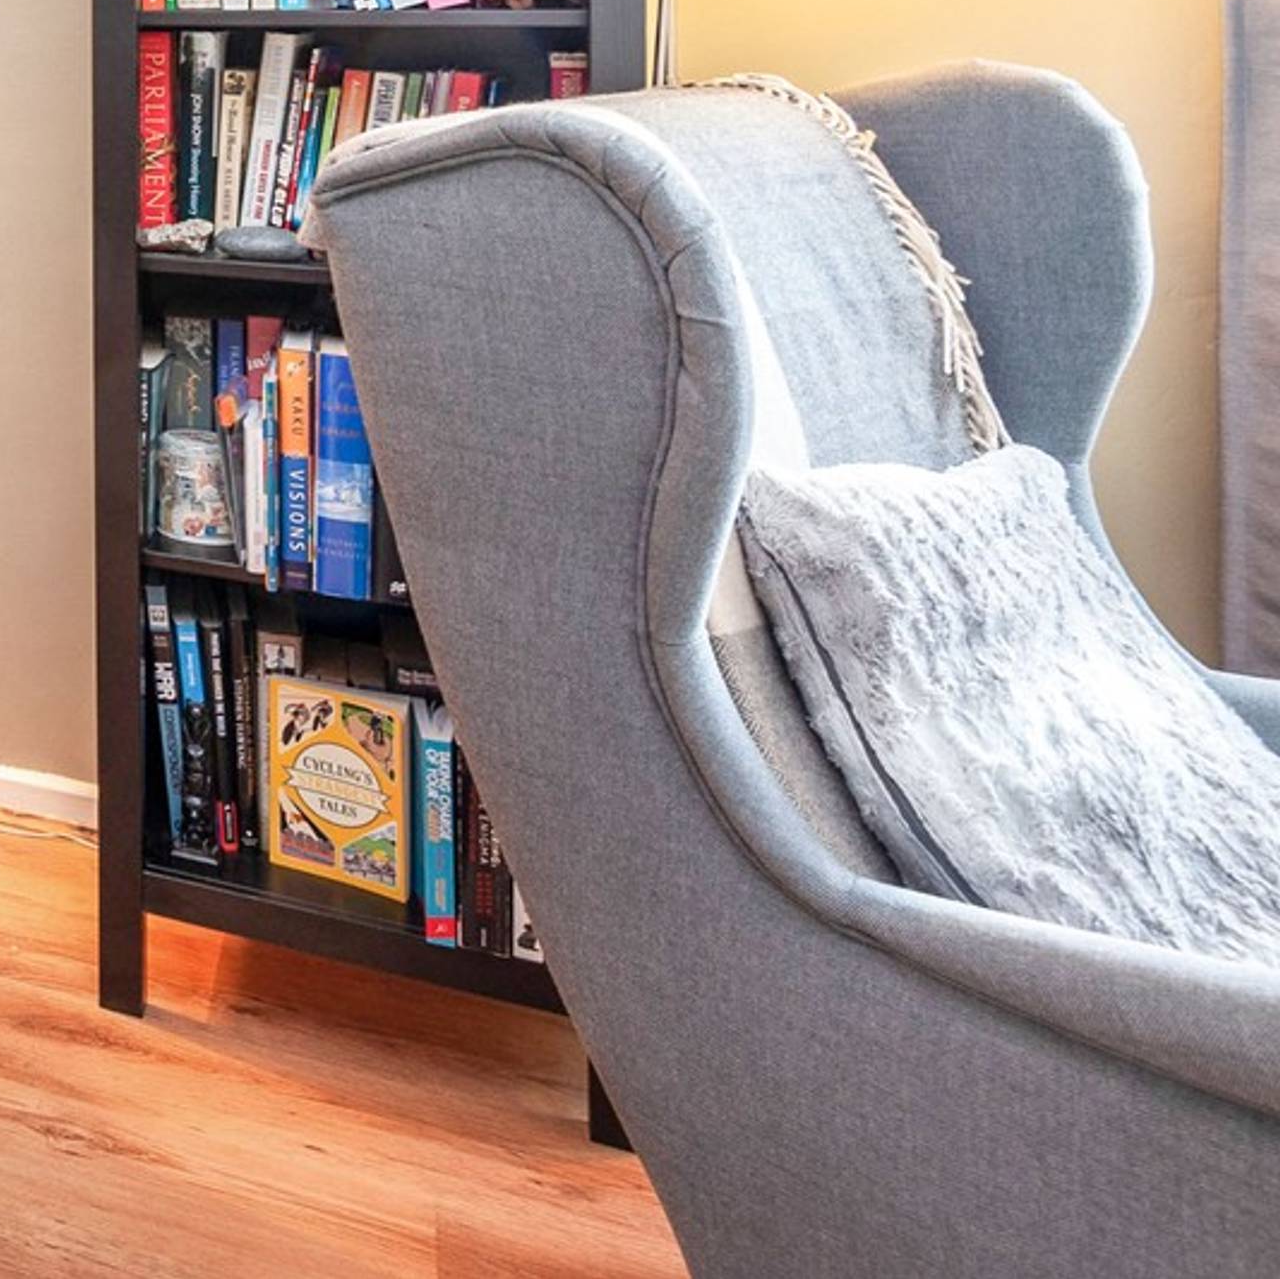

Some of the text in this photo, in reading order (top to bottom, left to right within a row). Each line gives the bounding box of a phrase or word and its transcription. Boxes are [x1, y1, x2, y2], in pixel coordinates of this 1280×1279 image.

[190, 94, 203, 115] JON
[144, 52, 167, 224] PARLIAMENT
[191, 116, 203, 147] SNOW
[188, 148, 202, 184] Shooting
[271, 188, 288, 228] CLUB
[291, 396, 305, 436] KAKU
[288, 470, 306, 552] VISIONS
[154, 662, 177, 700] WAR
[302, 756, 374, 785] CYCLING'S
[318, 797, 358, 818] TALES
